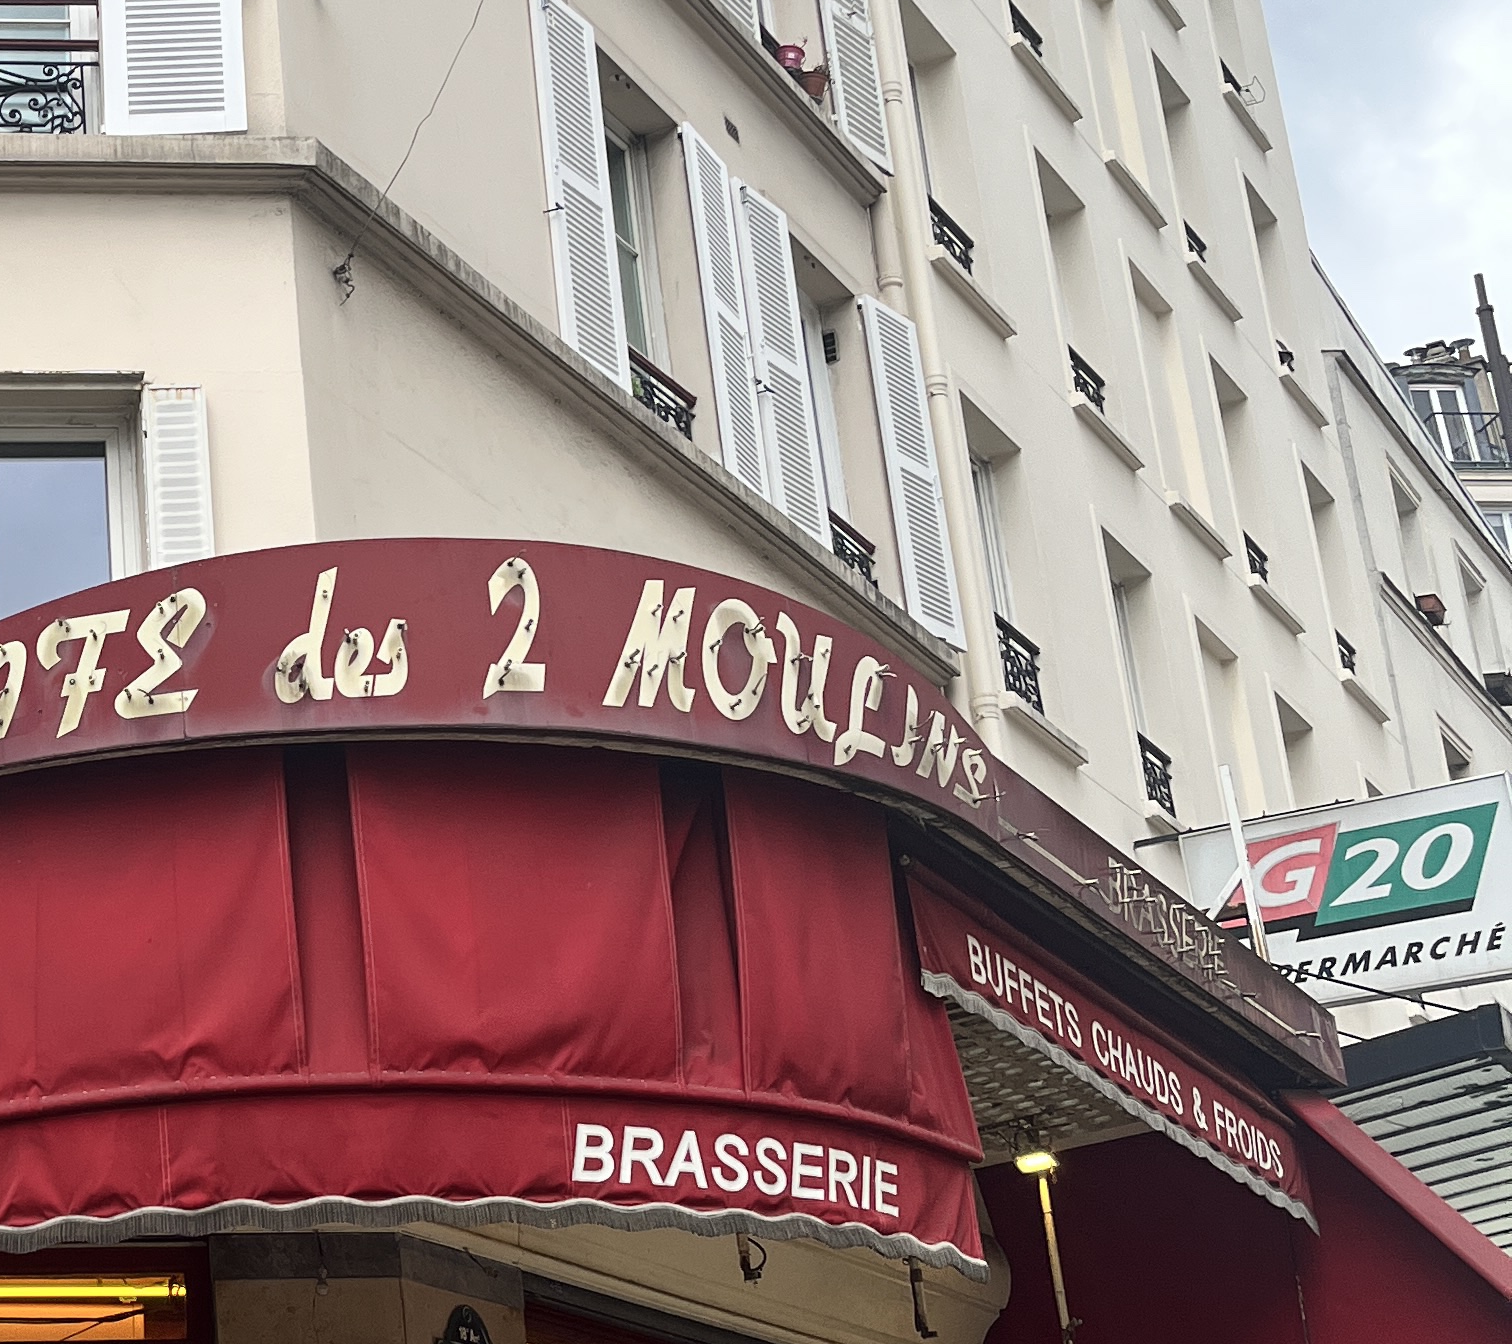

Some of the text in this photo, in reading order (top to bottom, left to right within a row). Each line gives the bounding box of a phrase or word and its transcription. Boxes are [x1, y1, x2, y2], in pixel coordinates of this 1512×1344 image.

[274, 566, 408, 704] des
[483, 556, 546, 700] 2
[602, 579, 988, 809] MOULINS
[1251, 822, 1474, 908] G20
[966, 934, 1284, 1179] BUFFETS CHAUDS & FROIDS
[571, 1123, 900, 1218] BRASSERIE
